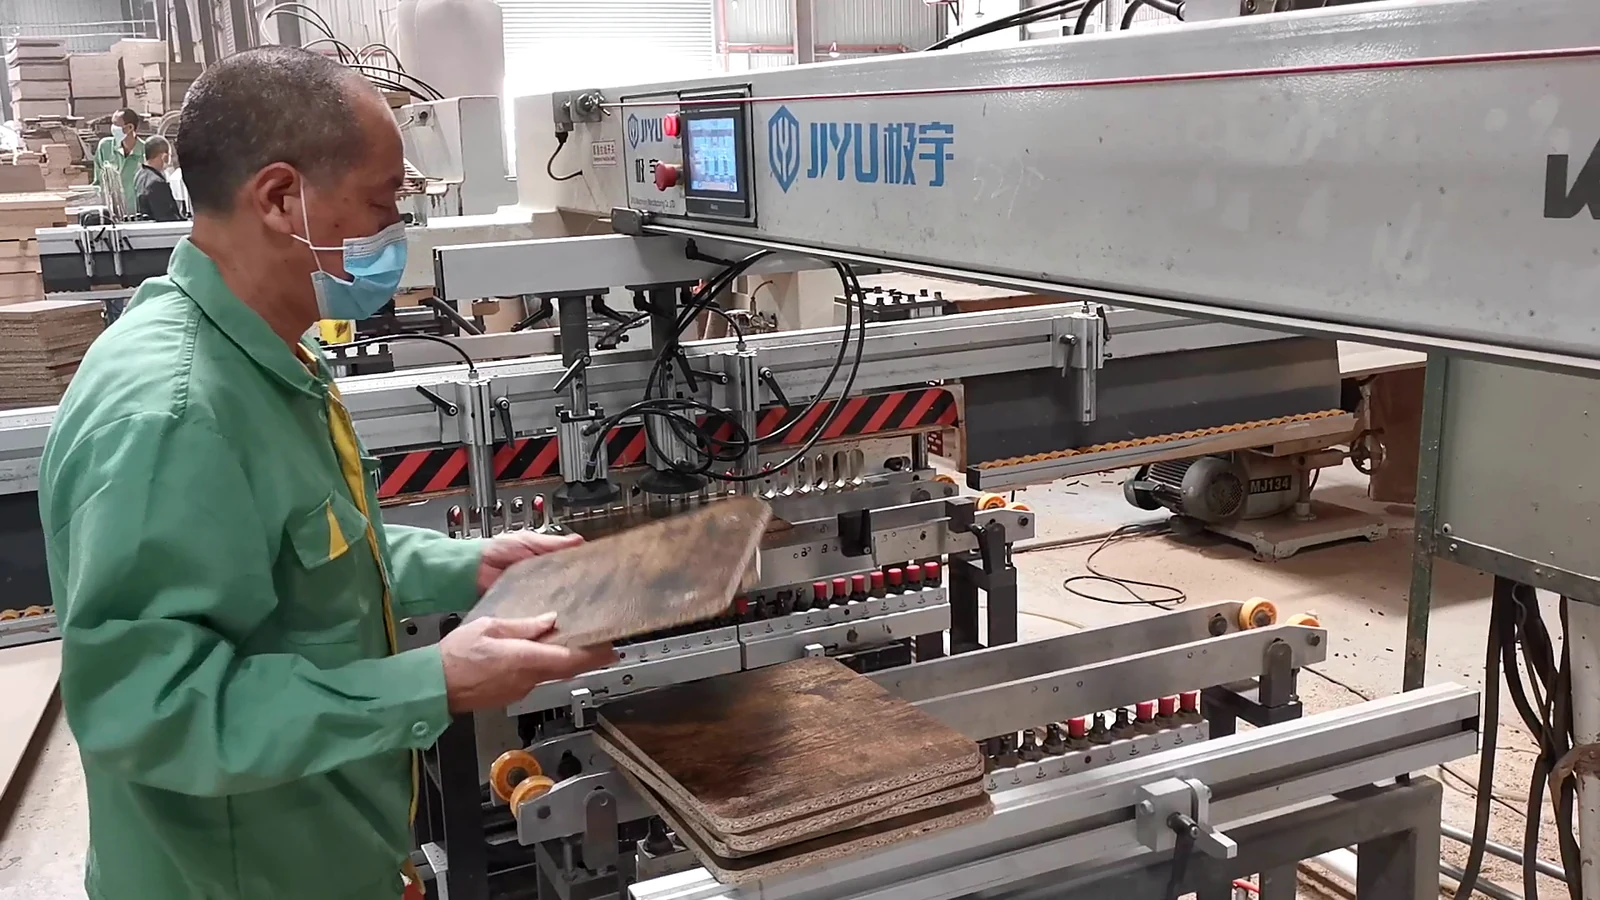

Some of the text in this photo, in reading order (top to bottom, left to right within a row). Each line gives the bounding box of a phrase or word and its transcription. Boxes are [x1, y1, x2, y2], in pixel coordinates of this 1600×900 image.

[641, 118, 663, 143] JIYU
[807, 122, 879, 183] JIYU
[883, 121, 954, 187] 极宇
[1250, 478, 1289, 493] MJ134
